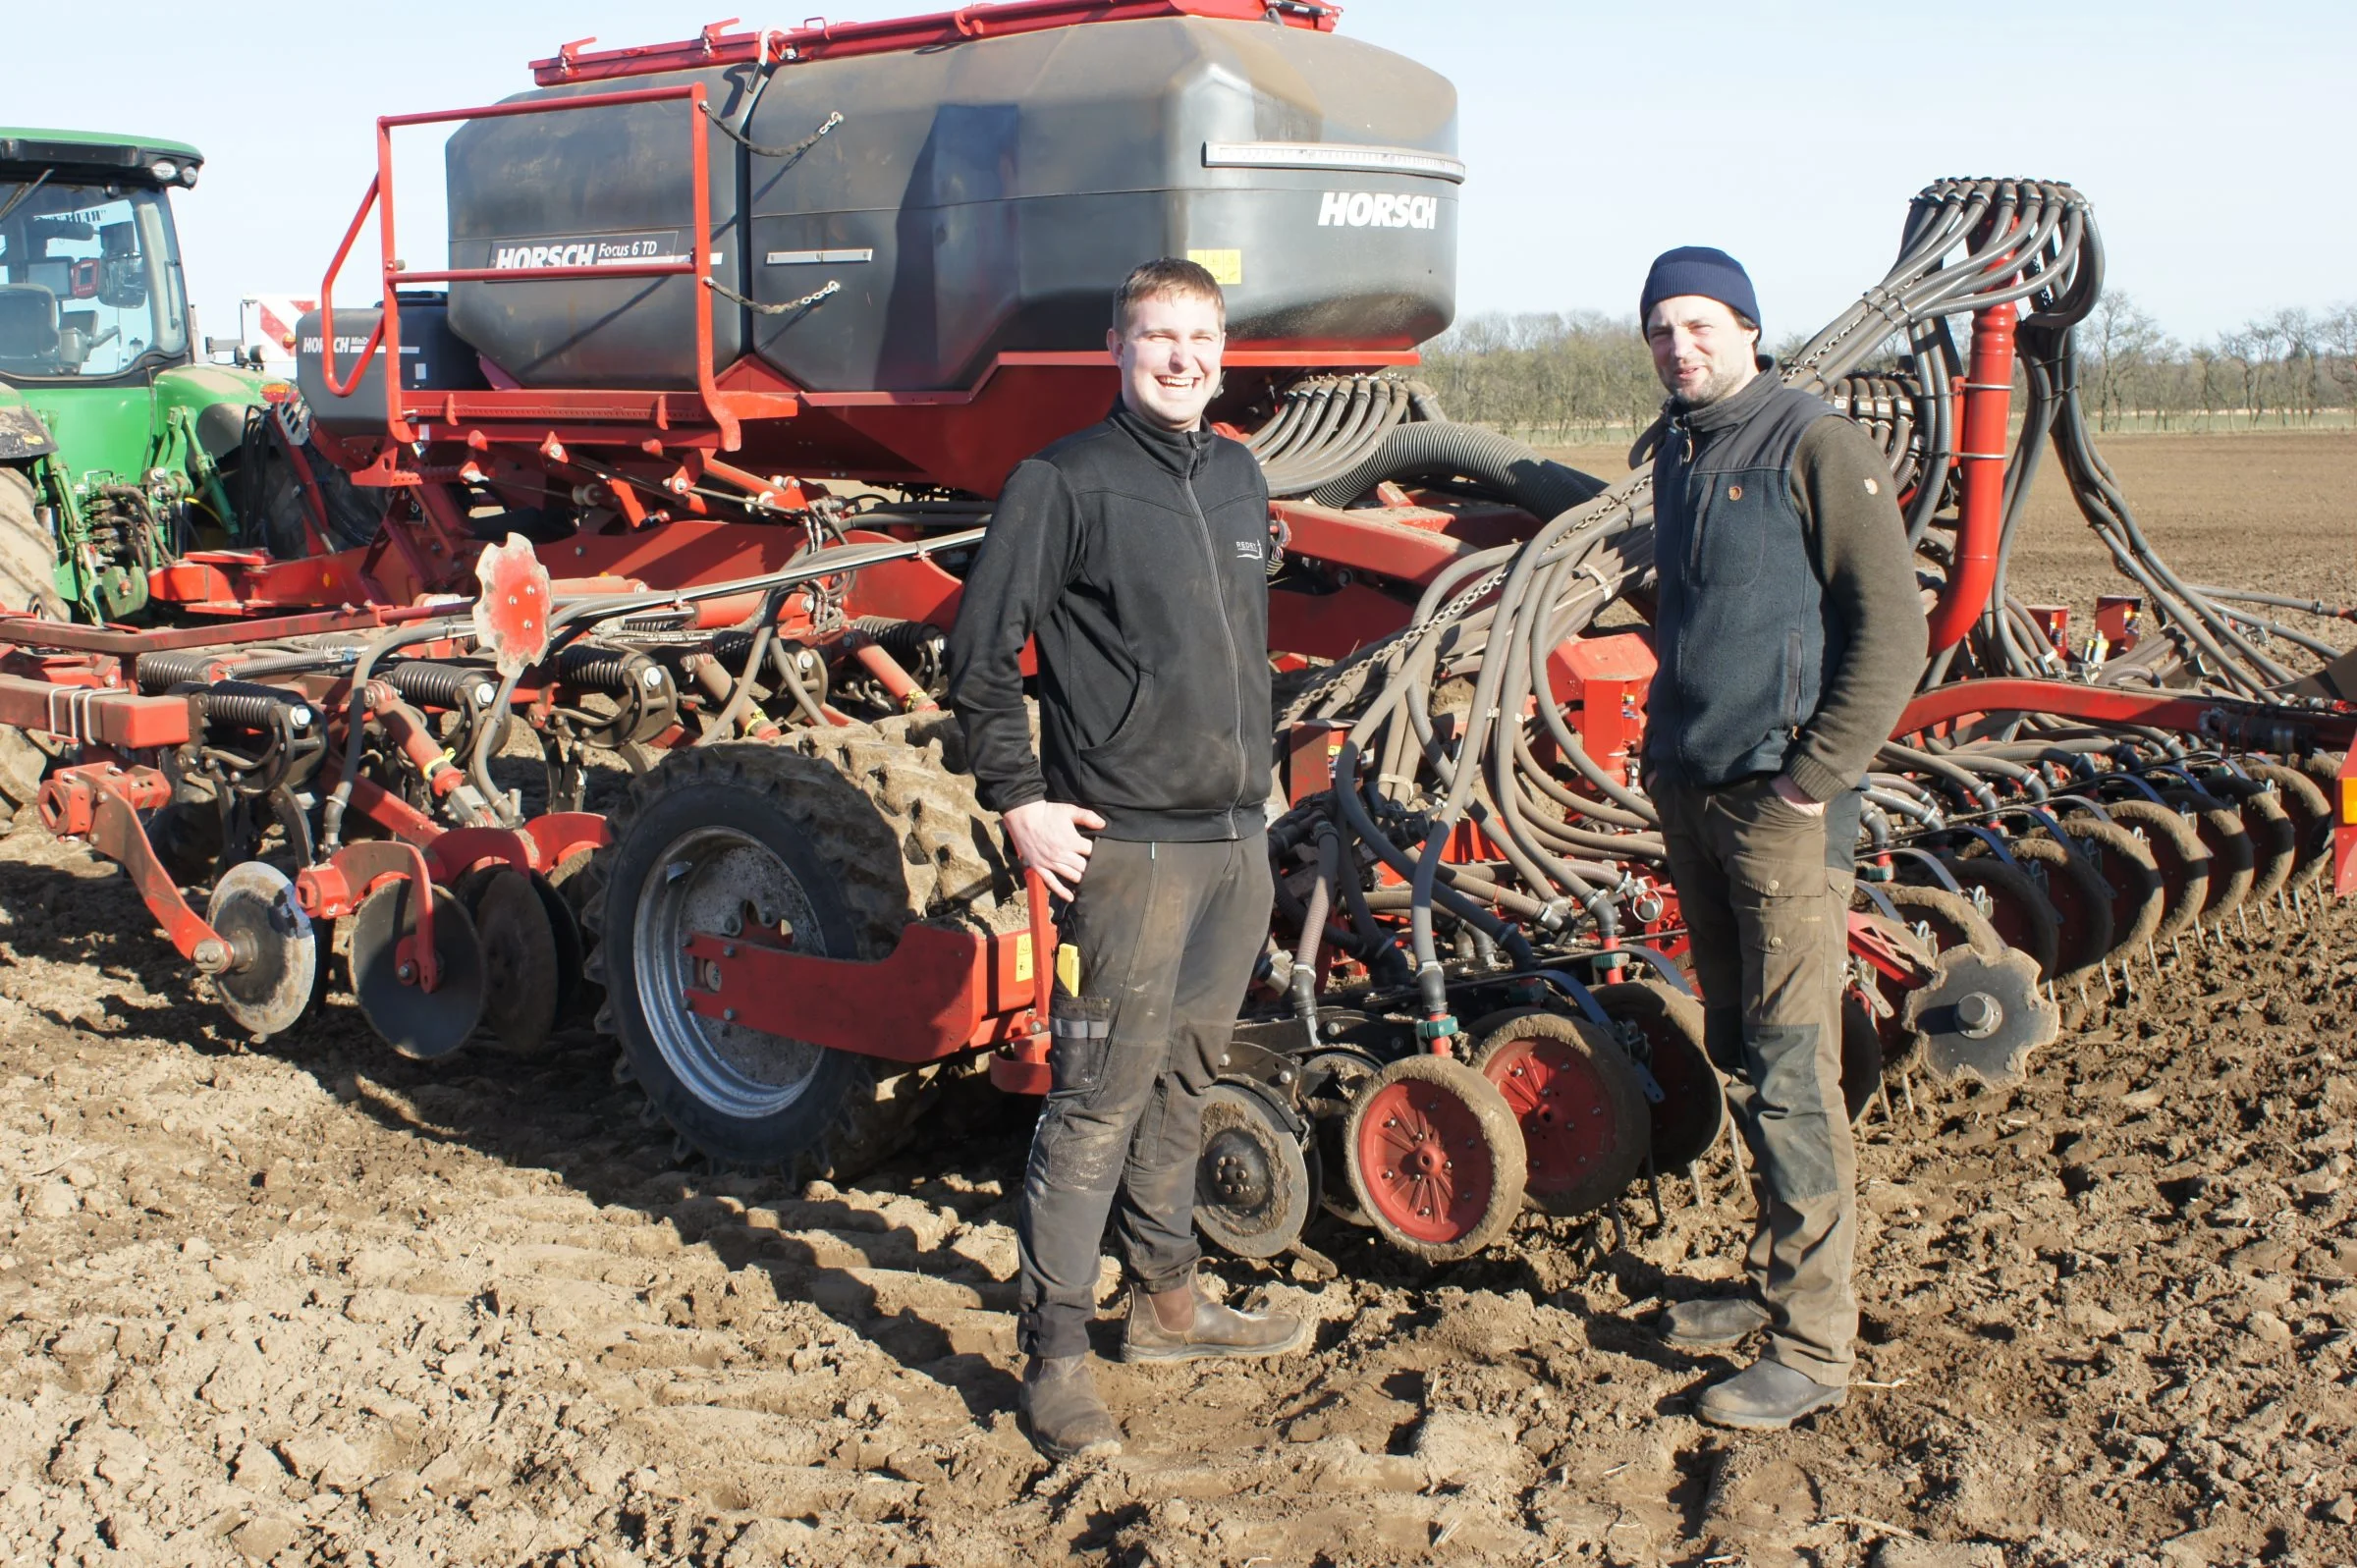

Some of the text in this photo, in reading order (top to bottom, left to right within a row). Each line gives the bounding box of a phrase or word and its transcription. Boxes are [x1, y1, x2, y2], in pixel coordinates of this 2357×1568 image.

[1318, 191, 1437, 230] HORSCH
[496, 241, 658, 269] HORSCH Focus 6 TD
